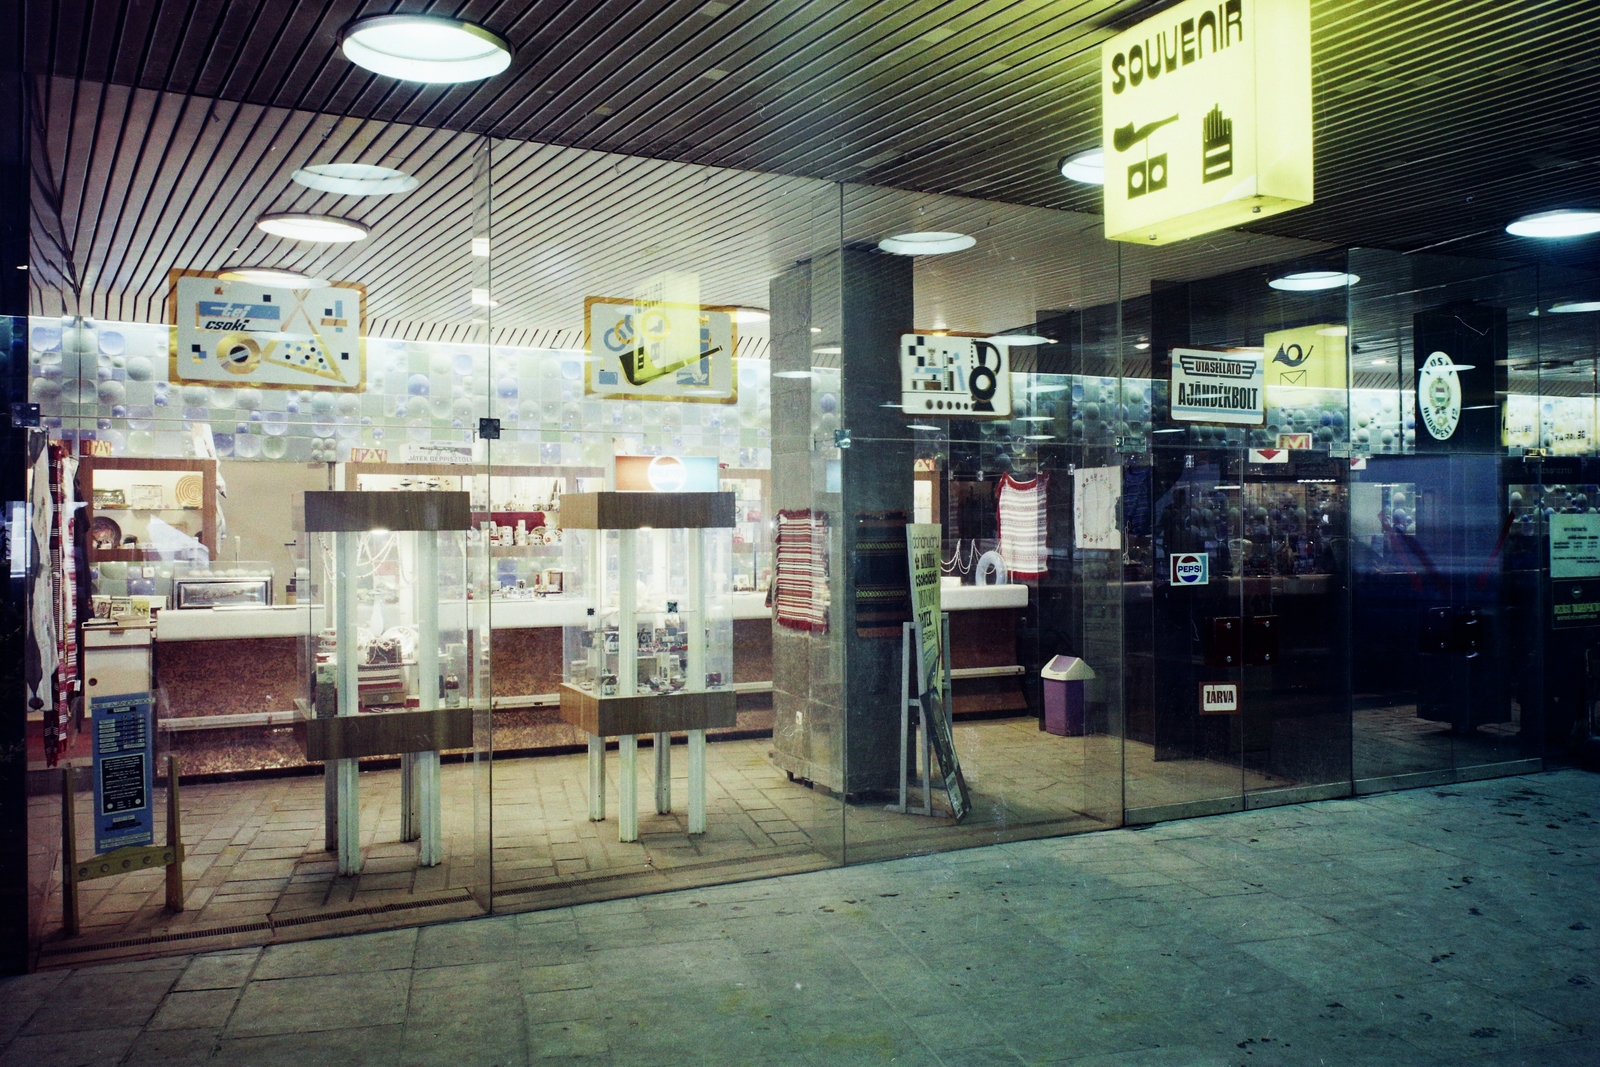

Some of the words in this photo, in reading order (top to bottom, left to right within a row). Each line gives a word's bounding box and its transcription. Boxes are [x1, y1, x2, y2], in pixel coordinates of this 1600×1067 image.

[1111, 0, 1243, 95] SOUVENIR
[205, 319, 253, 332] csoki
[1178, 381, 1258, 410] AJÁNDÉKBOLT
[1177, 565, 1202, 573] PEPSI
